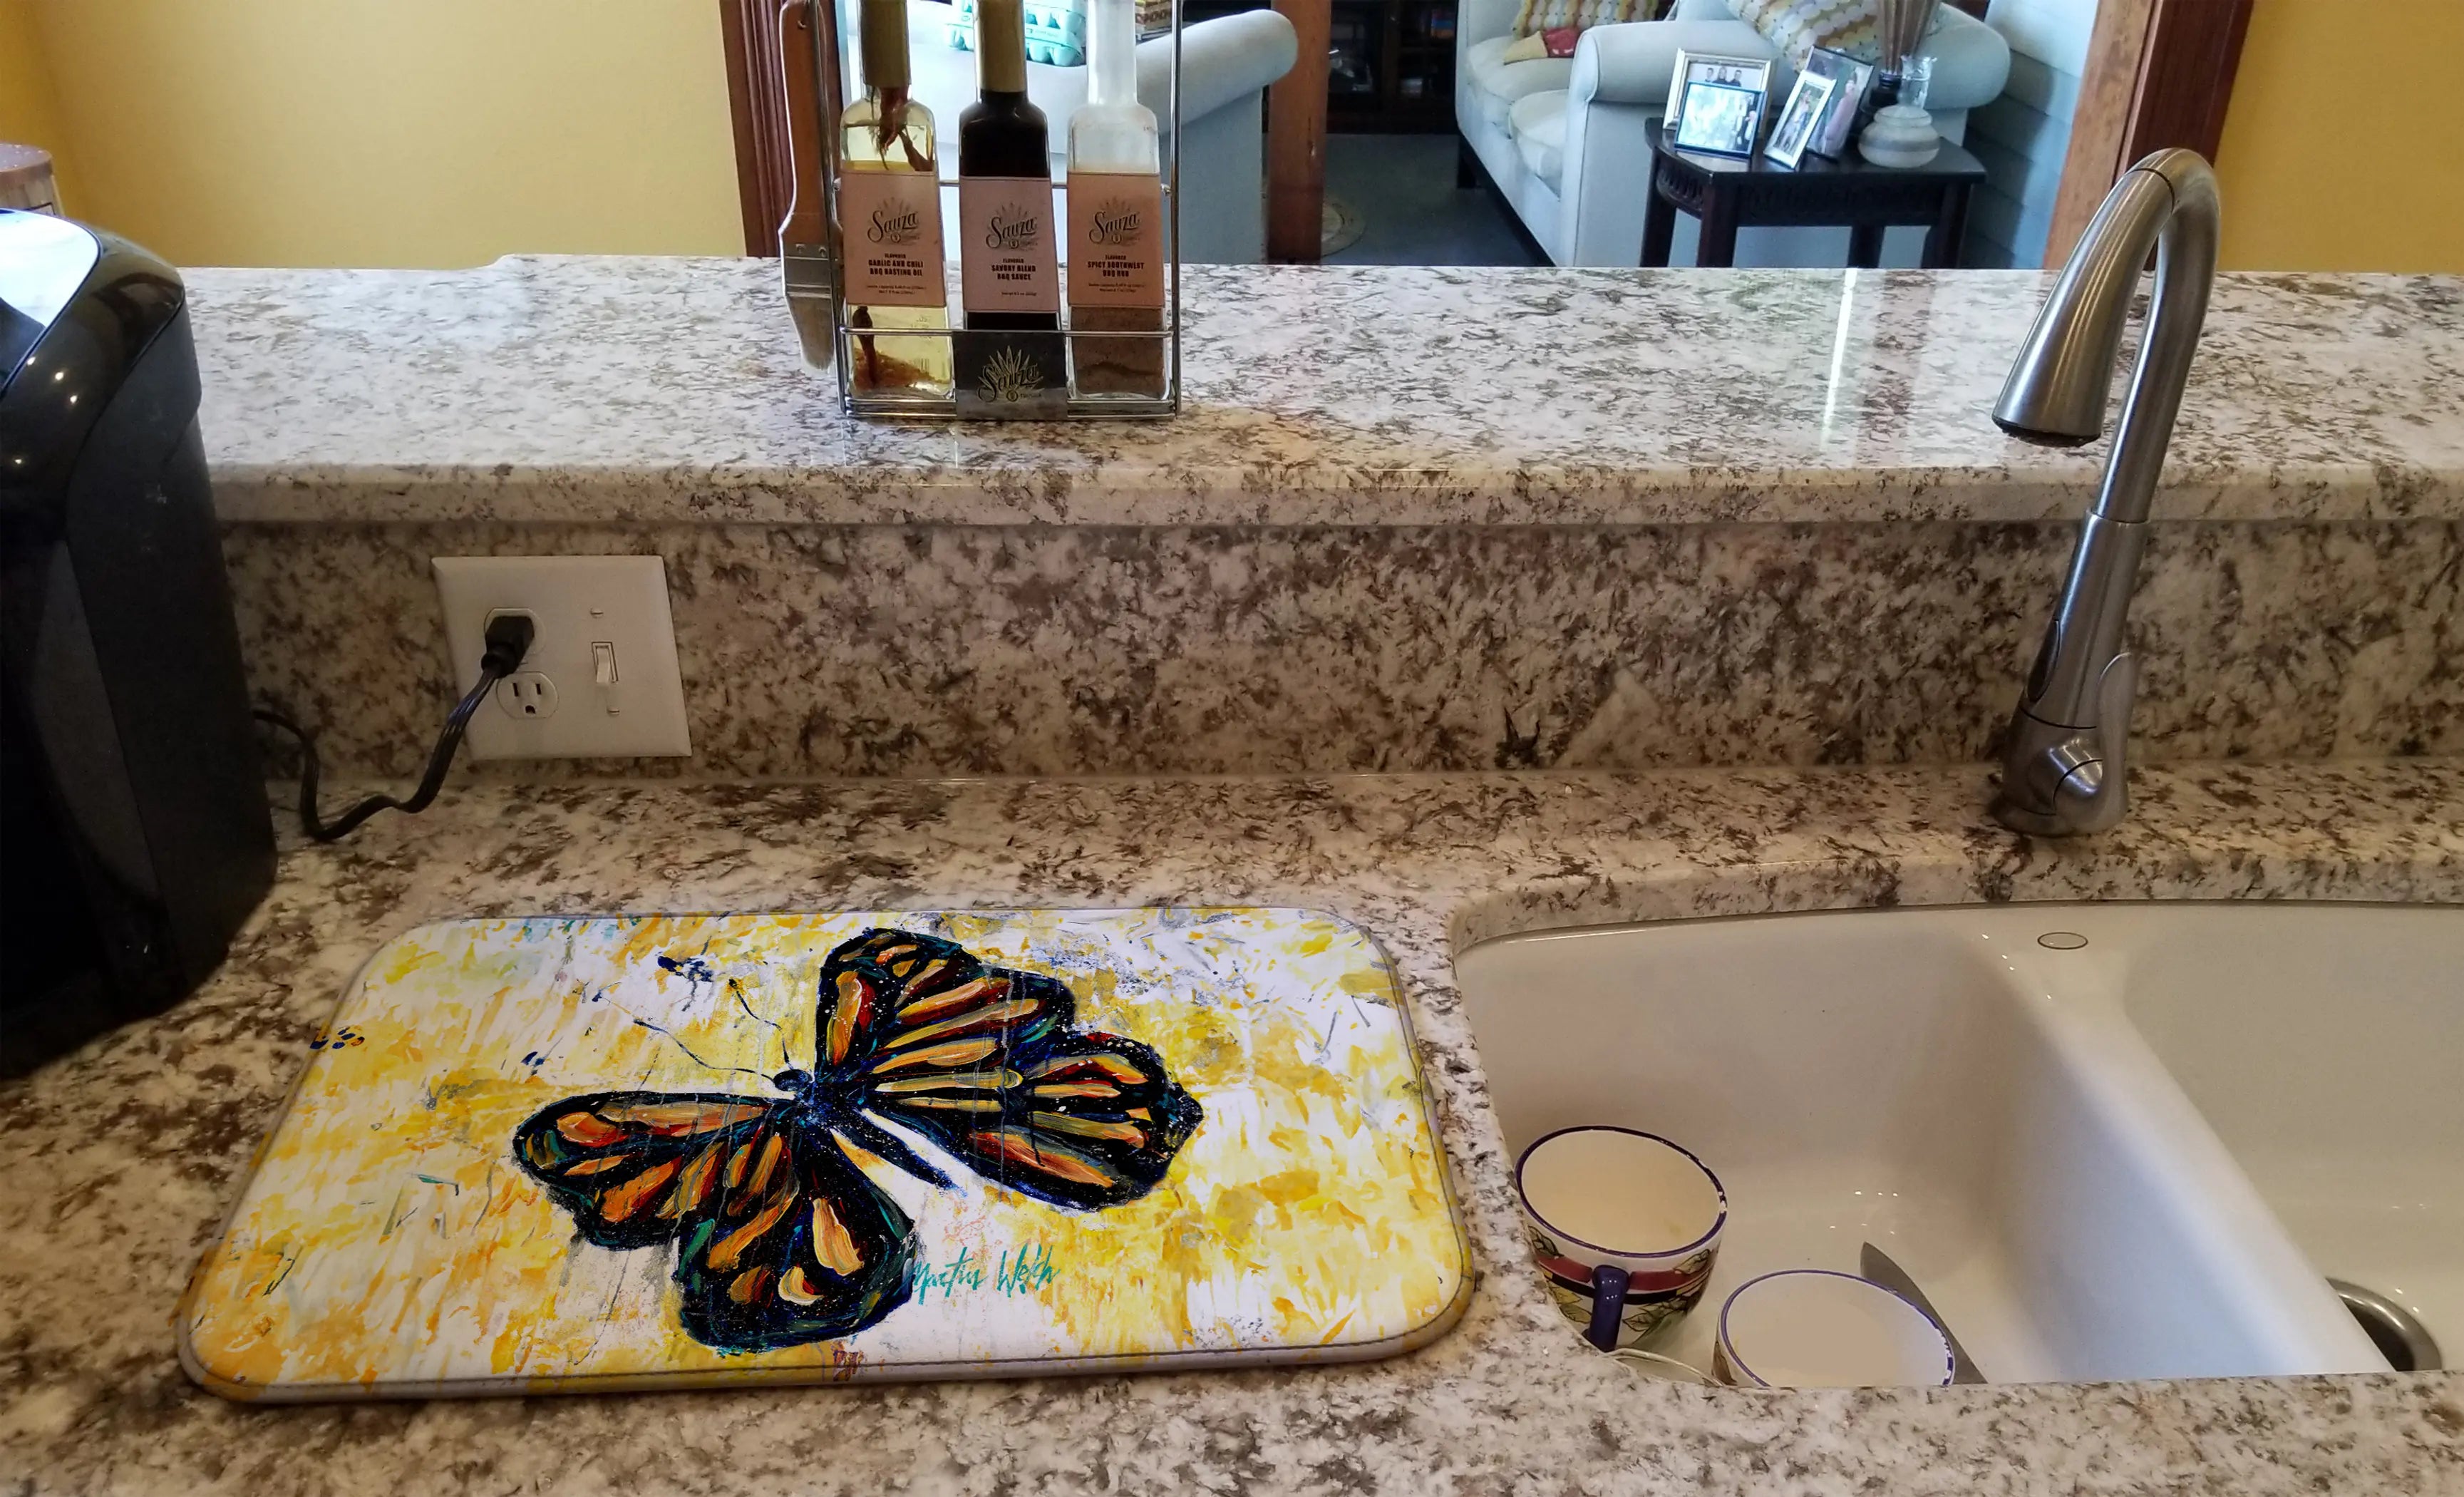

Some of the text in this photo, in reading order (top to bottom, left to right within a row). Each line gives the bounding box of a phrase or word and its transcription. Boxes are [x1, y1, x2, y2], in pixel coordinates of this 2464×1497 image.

[867, 210, 919, 243] Sauza
[986, 216, 1038, 249] Sauza
[1088, 211, 1140, 244] Sauza
[885, 268, 912, 277] BASTING
[977, 364, 1040, 403] Sauza
